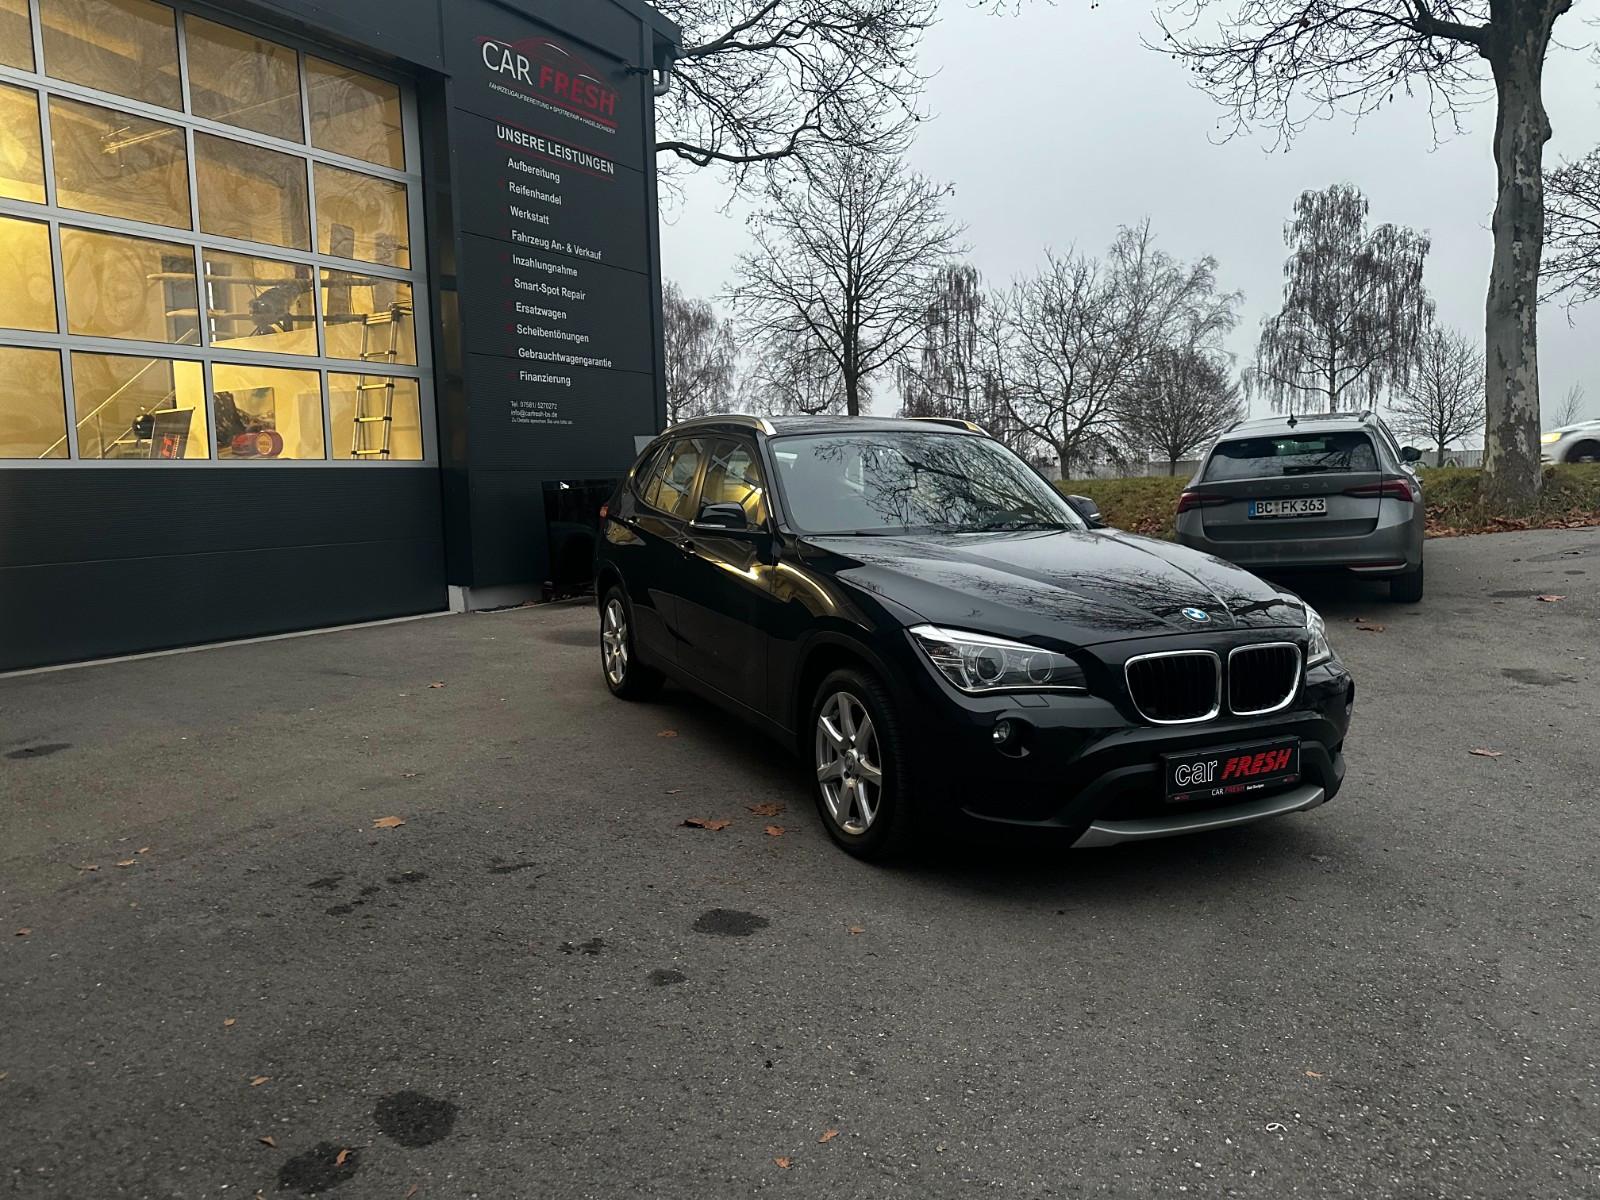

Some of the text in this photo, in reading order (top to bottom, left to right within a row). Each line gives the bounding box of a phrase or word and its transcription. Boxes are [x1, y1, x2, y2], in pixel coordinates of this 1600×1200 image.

[482, 41, 616, 116] CAR FRESH
[496, 124, 615, 175] UNSERE LEISTUNGEN
[507, 157, 560, 184] Aufbereitung
[509, 181, 562, 206] Reifenhandel
[510, 205, 550, 225] Werkstatt
[511, 229, 602, 260] Fahrzeug An- & Verkauf
[512, 254, 578, 277] Inzahlungnahme
[514, 278, 586, 301] Smart-Spot Repair
[515, 302, 567, 320] Ersatzwagen
[516, 323, 589, 344] Scheibentönungen
[518, 347, 612, 368] Gebrauchtwagengarantie
[519, 370, 571, 387] Finanzierung
[1256, 499, 1325, 514] BC FK 363
[1174, 747, 1293, 787] car FRESH
[1211, 788, 1224, 796] CAR
